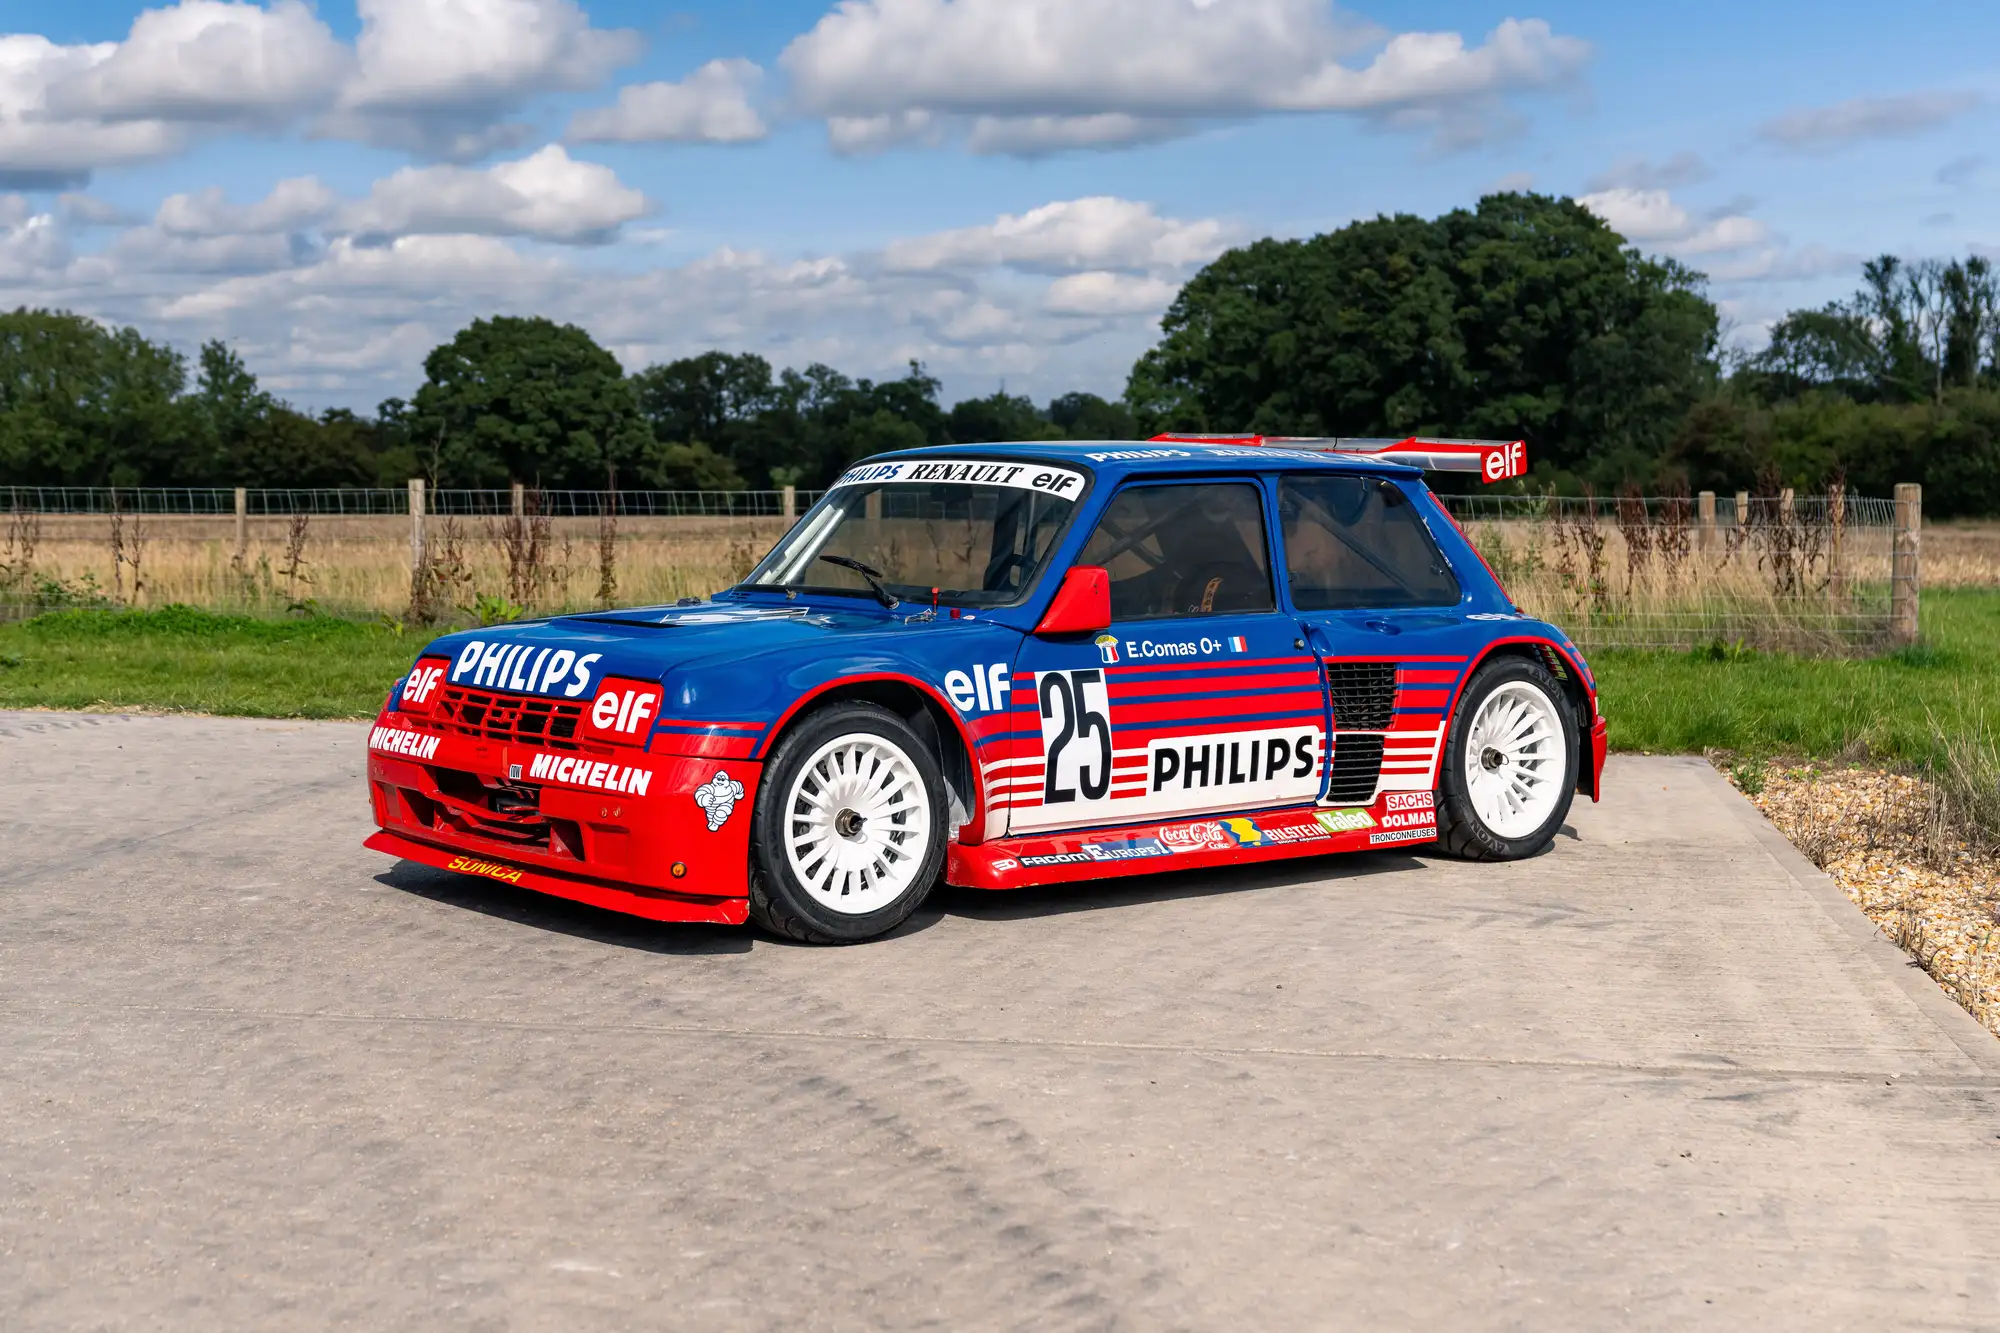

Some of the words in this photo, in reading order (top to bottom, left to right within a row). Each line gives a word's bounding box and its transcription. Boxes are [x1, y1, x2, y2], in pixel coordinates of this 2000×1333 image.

[1084, 449, 1191, 462] PHILIPS
[1486, 441, 1522, 480] elf
[905, 463, 1025, 482] RENAULT
[1031, 473, 1077, 493] elf
[1126, 640, 1197, 658] E.Comas
[1200, 637, 1222, 655] O+
[452, 640, 602, 697] PHILIPS
[402, 667, 443, 703] elf
[944, 663, 1011, 712] elf
[592, 690, 656, 734] elf
[370, 727, 440, 760] MICHELIN
[1040, 669, 1113, 805] 25
[530, 753, 652, 797] MICHELIN
[1153, 736, 1315, 792] PHILIPS
[1388, 793, 1433, 809] SACHS
[1263, 823, 1329, 841] BILSTEIN
[1317, 811, 1373, 831] Valeo
[1381, 811, 1435, 828] DOLMAR
[1159, 821, 1224, 847] Coca-Cola
[1208, 841, 1230, 849] Coke
[1371, 828, 1436, 843] TRONCONNEUSES
[1020, 851, 1088, 866] FACOM
